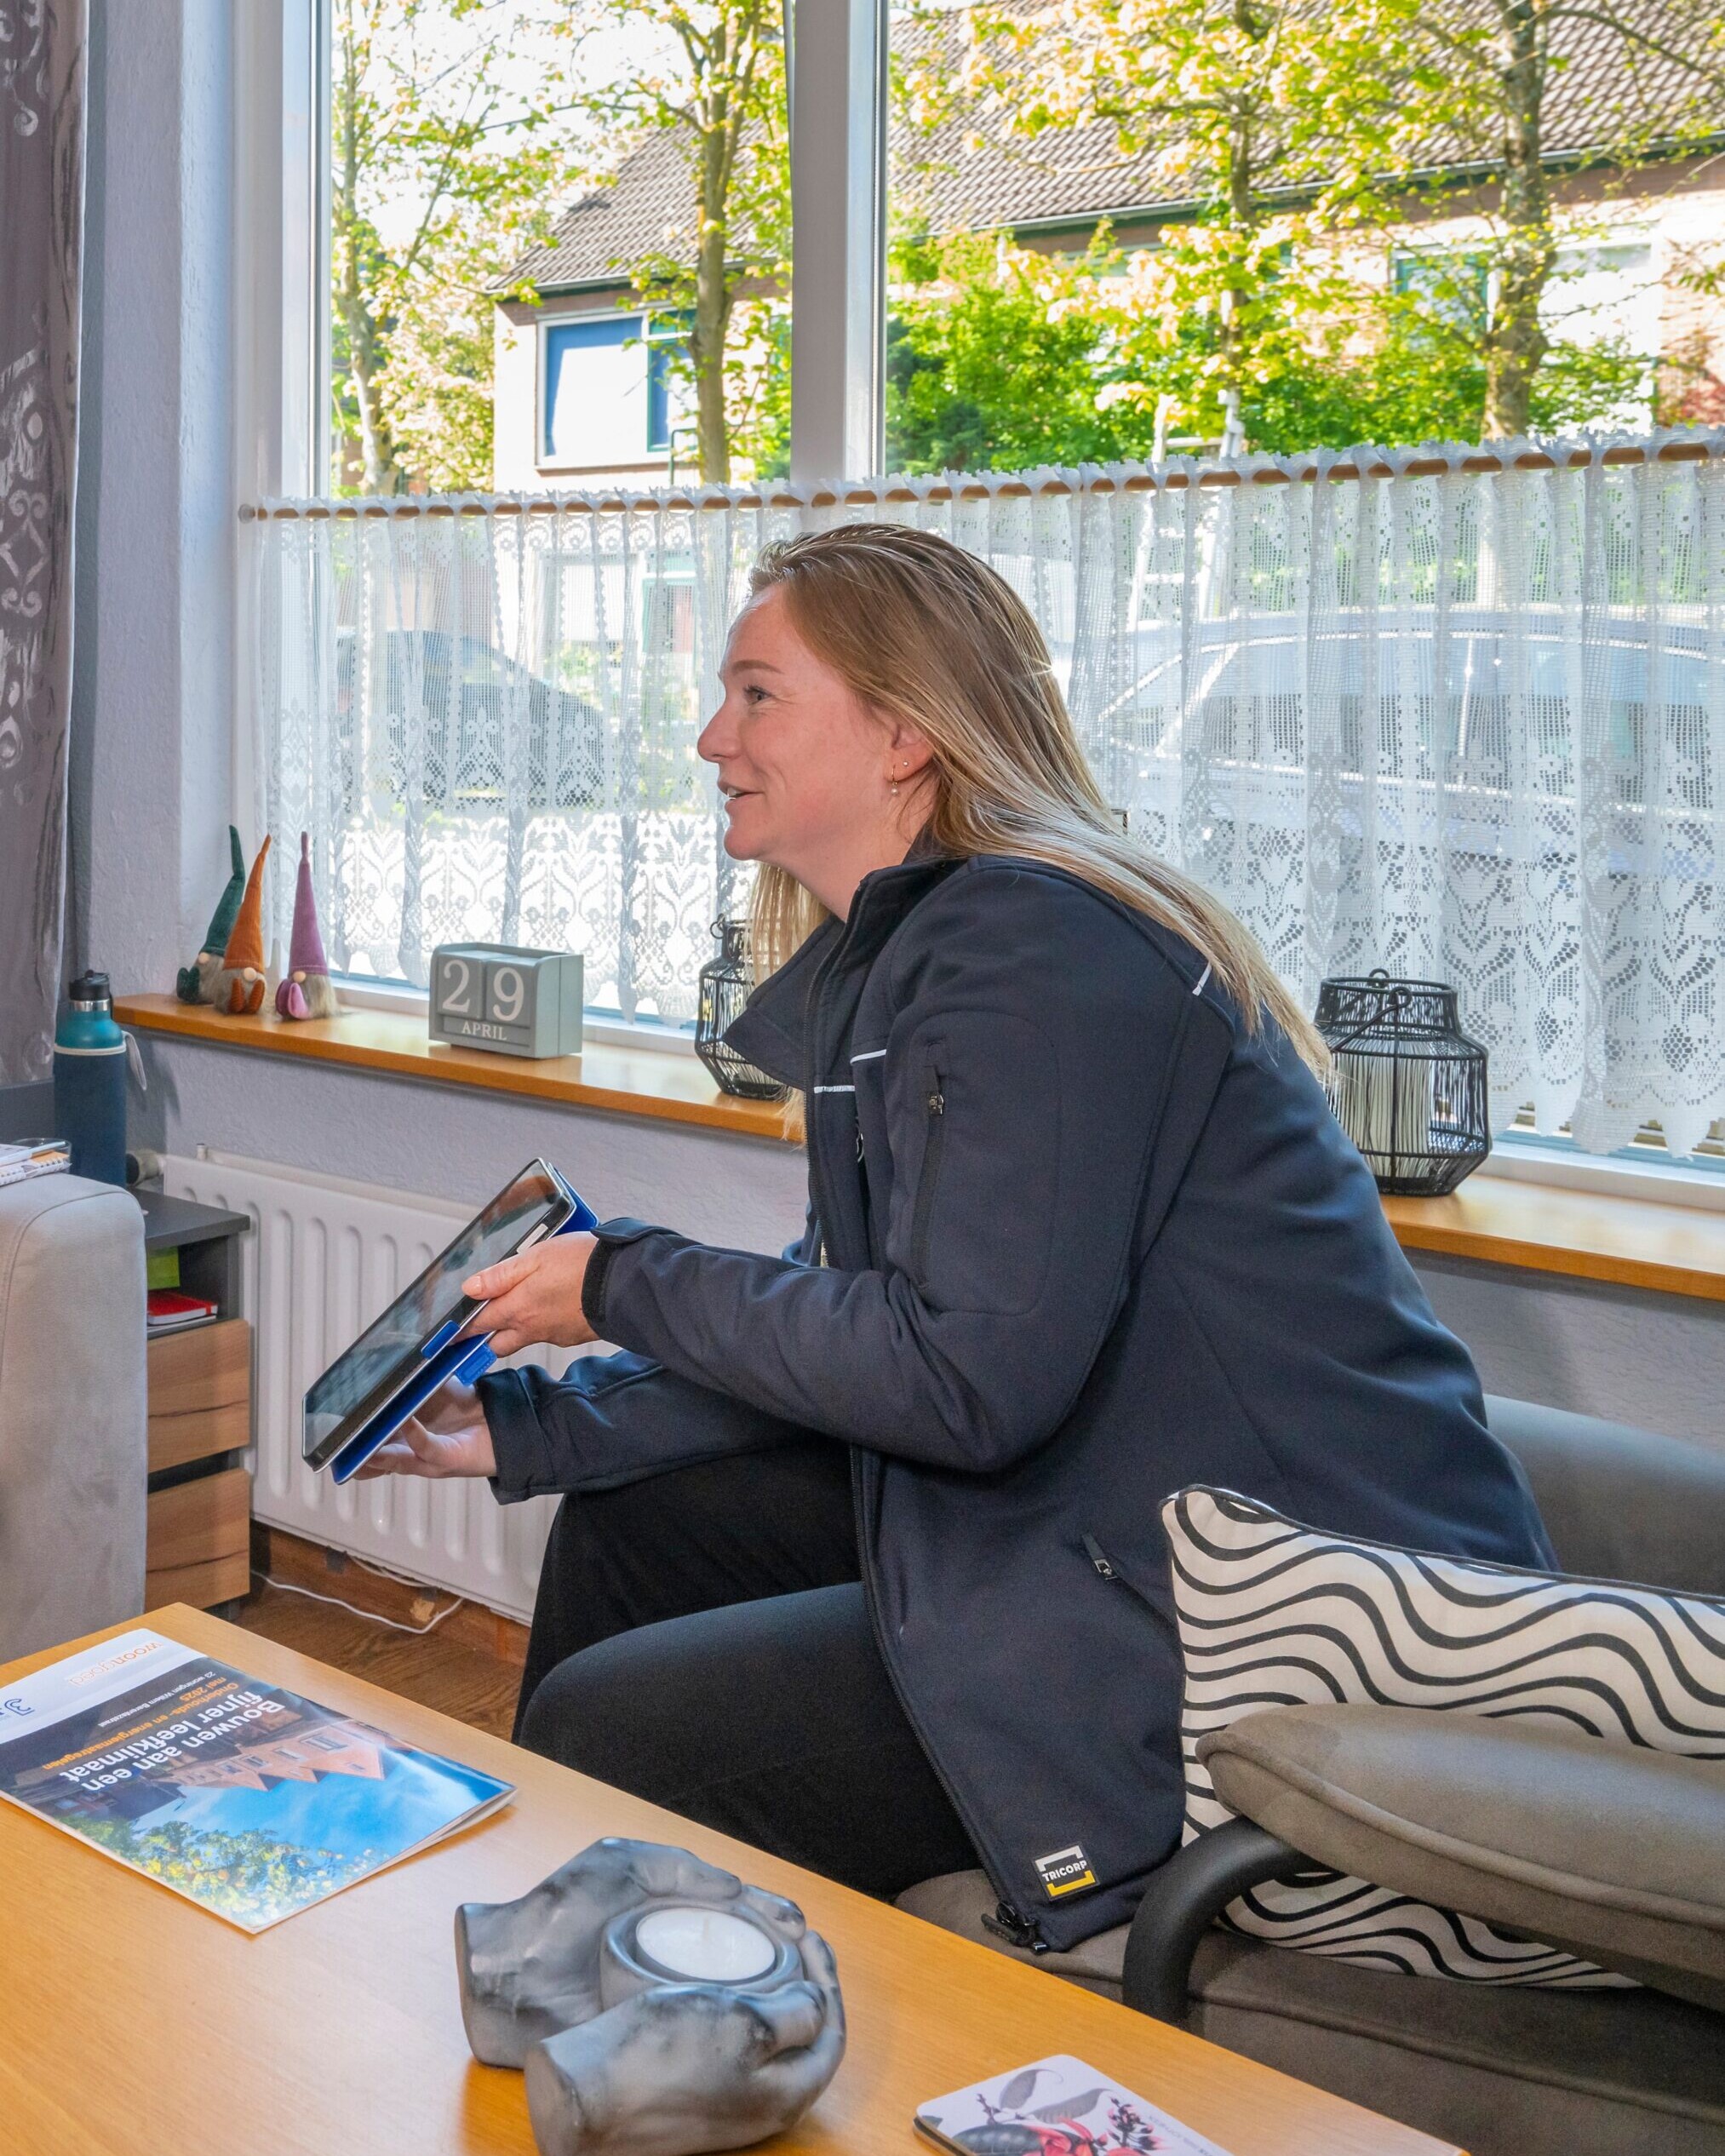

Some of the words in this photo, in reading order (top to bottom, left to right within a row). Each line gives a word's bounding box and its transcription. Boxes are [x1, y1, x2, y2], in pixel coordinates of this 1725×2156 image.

[461, 1021, 507, 1041] APRIL
[173, 1674, 206, 1694] woningen
[204, 1671, 216, 1680] 23
[205, 1676, 227, 1690] mei
[147, 1689, 174, 1706] Willem
[168, 1681, 239, 1717] Onderhouds-
[178, 1686, 207, 1702] 2025
[193, 1690, 263, 1727] fijner
[152, 1714, 169, 1728] en
[181, 1700, 285, 1750] Bouwen
[42, 1721, 153, 1771] energiemaatregelen
[59, 1720, 195, 1785] leefklimaat
[132, 1746, 182, 1774] aan
[81, 1767, 133, 1794] een
[1041, 1860, 1088, 1882] TRICORP
